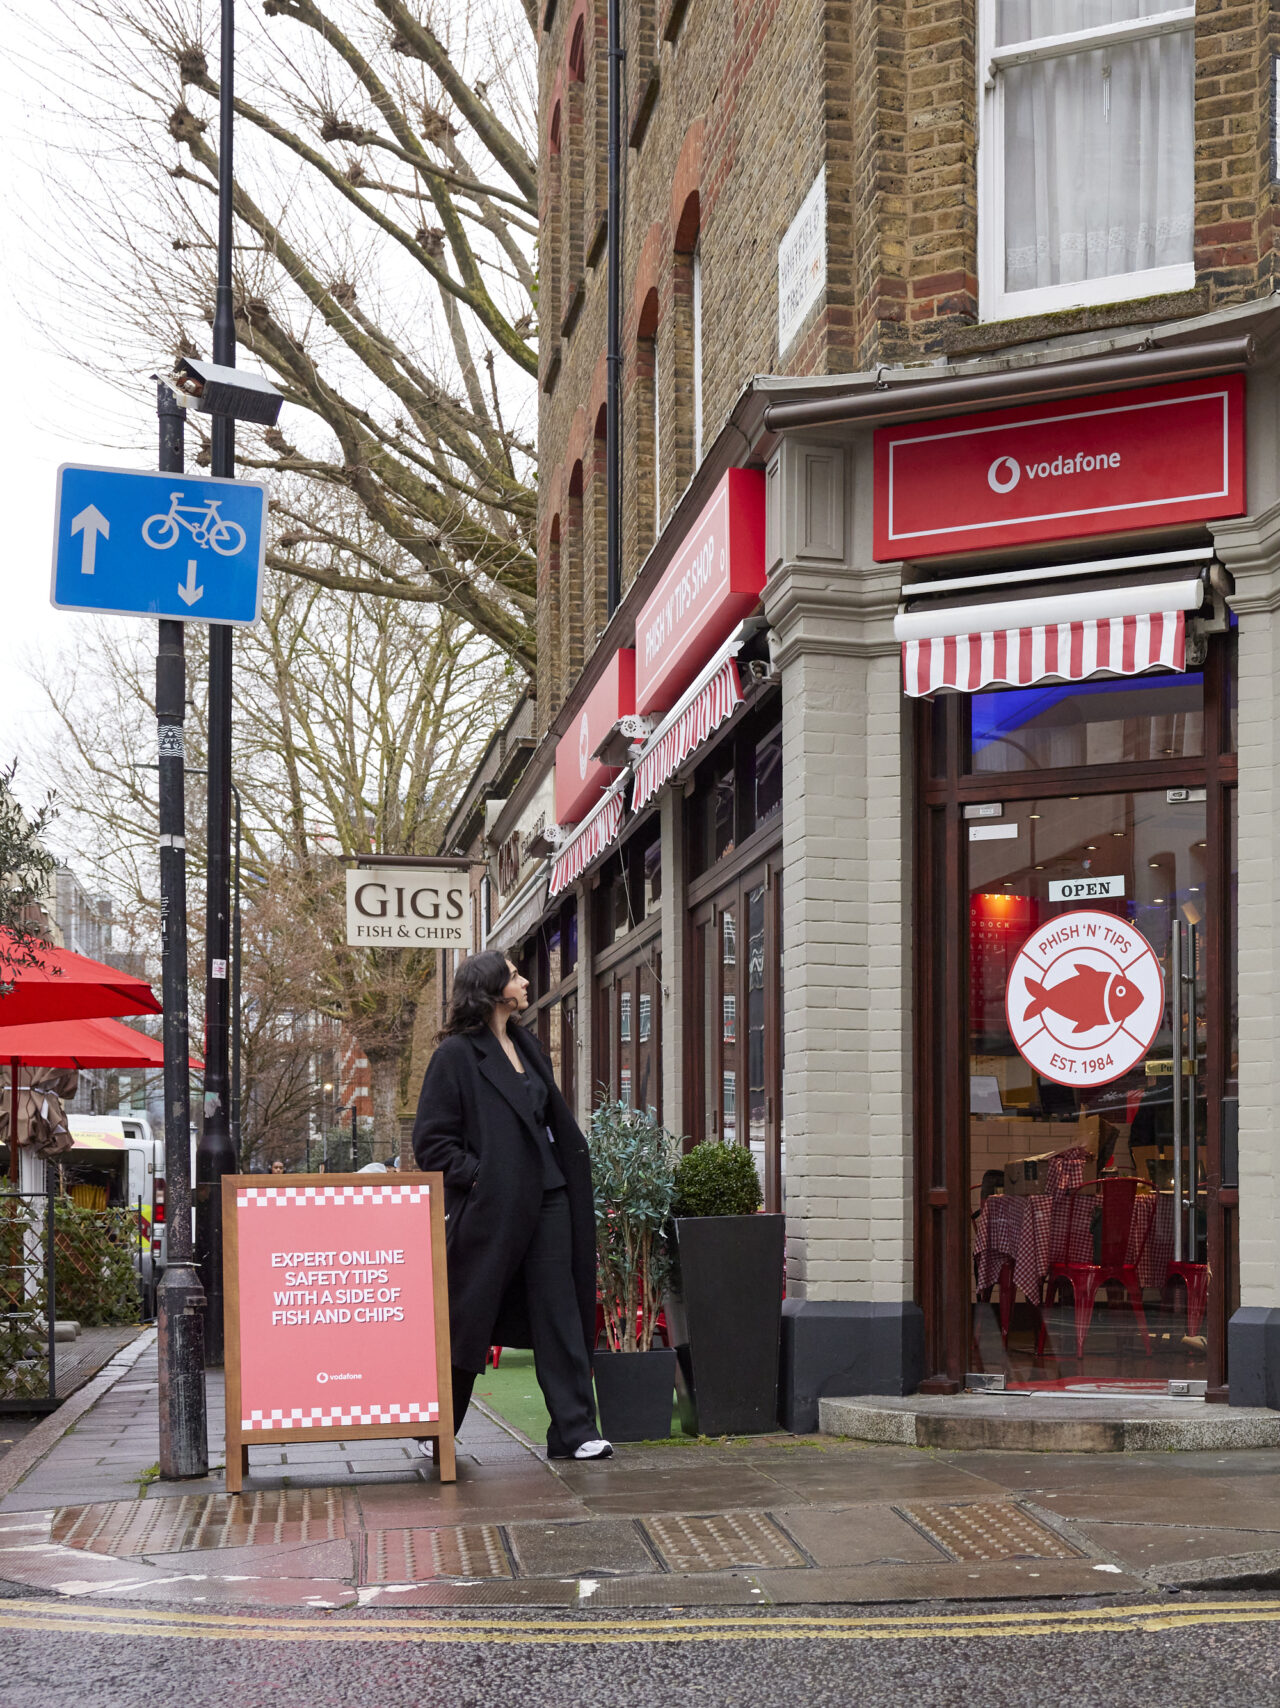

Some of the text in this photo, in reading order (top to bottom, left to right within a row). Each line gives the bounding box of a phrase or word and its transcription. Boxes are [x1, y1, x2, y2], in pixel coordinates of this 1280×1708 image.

[1025, 452, 1121, 480] vodafone
[645, 607, 665, 668] PHISH
[673, 569, 692, 623] TIPS
[691, 535, 715, 600] SHOP
[1061, 882, 1111, 898] OPEN
[354, 882, 464, 920] GIGS
[356, 924, 462, 940] FISH & CHIPS
[1038, 923, 1081, 956] PHISH
[1103, 930, 1133, 955] TIPS
[1049, 1052, 1114, 1075] EST. 1984
[271, 1249, 406, 1268] EXPERT ONLINE
[284, 1268, 390, 1287] SAFETY TIPS
[273, 1287, 402, 1306] WITH A SIDE OF
[272, 1306, 406, 1326] FISH AND CHIPS
[330, 1372, 363, 1381] vodafone
